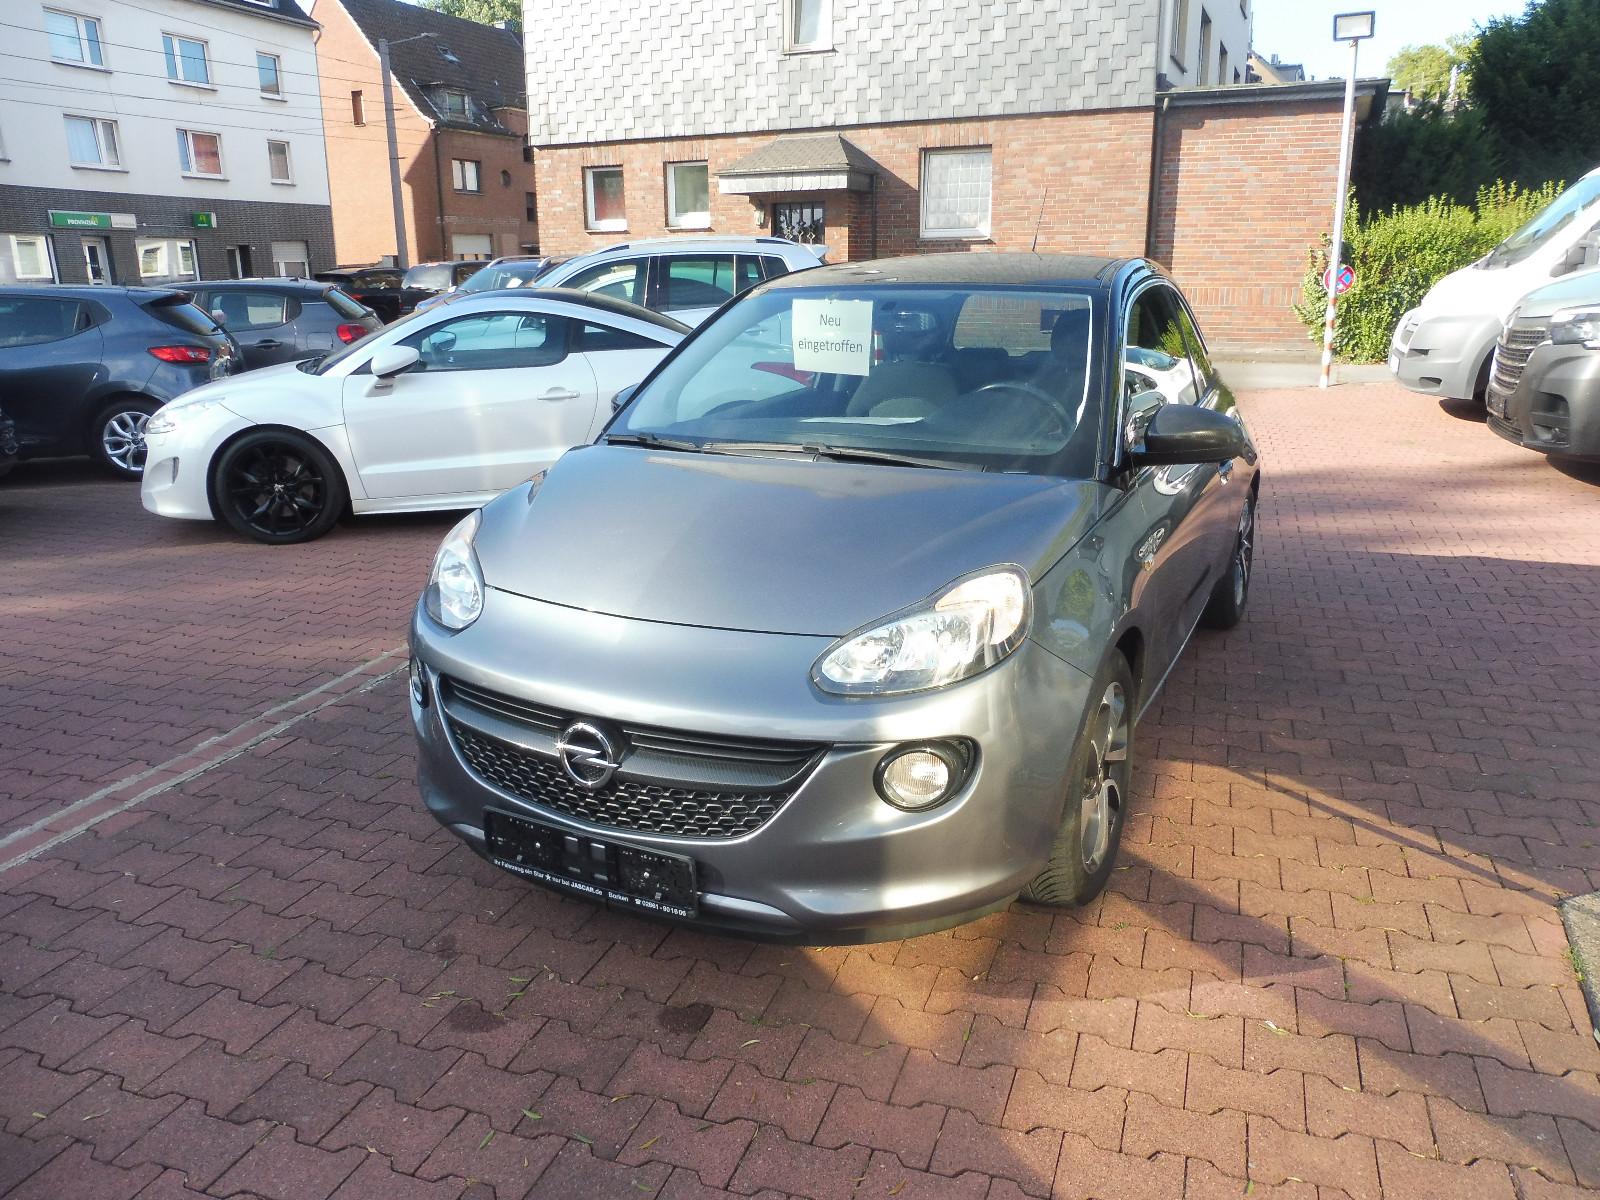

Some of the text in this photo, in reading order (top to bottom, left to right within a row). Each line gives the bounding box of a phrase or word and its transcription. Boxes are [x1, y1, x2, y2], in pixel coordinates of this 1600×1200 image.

[819, 314, 841, 327] Neu
[798, 338, 863, 353] eingetroffen
[501, 861, 525, 874] Fahrzeug
[533, 870, 544, 879] Star
[570, 881, 603, 896] JASCAR.de
[608, 891, 629, 902] Borken
